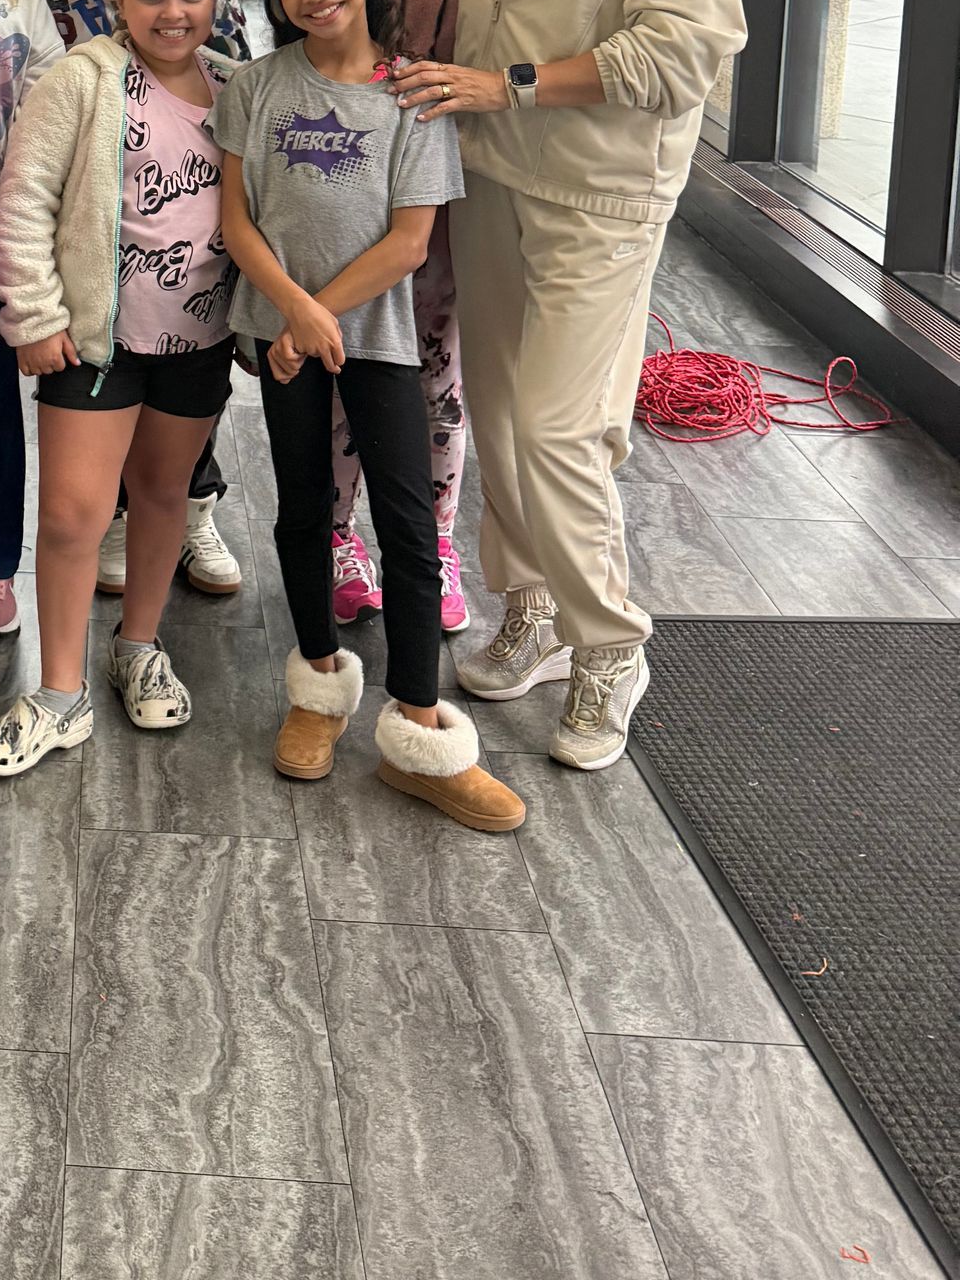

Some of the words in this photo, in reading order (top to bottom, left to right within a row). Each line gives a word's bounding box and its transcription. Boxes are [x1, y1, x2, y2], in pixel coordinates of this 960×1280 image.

[282, 130, 357, 153] FIERCE!
[134, 148, 221, 216] Barbie
[119, 240, 193, 291] Barb
